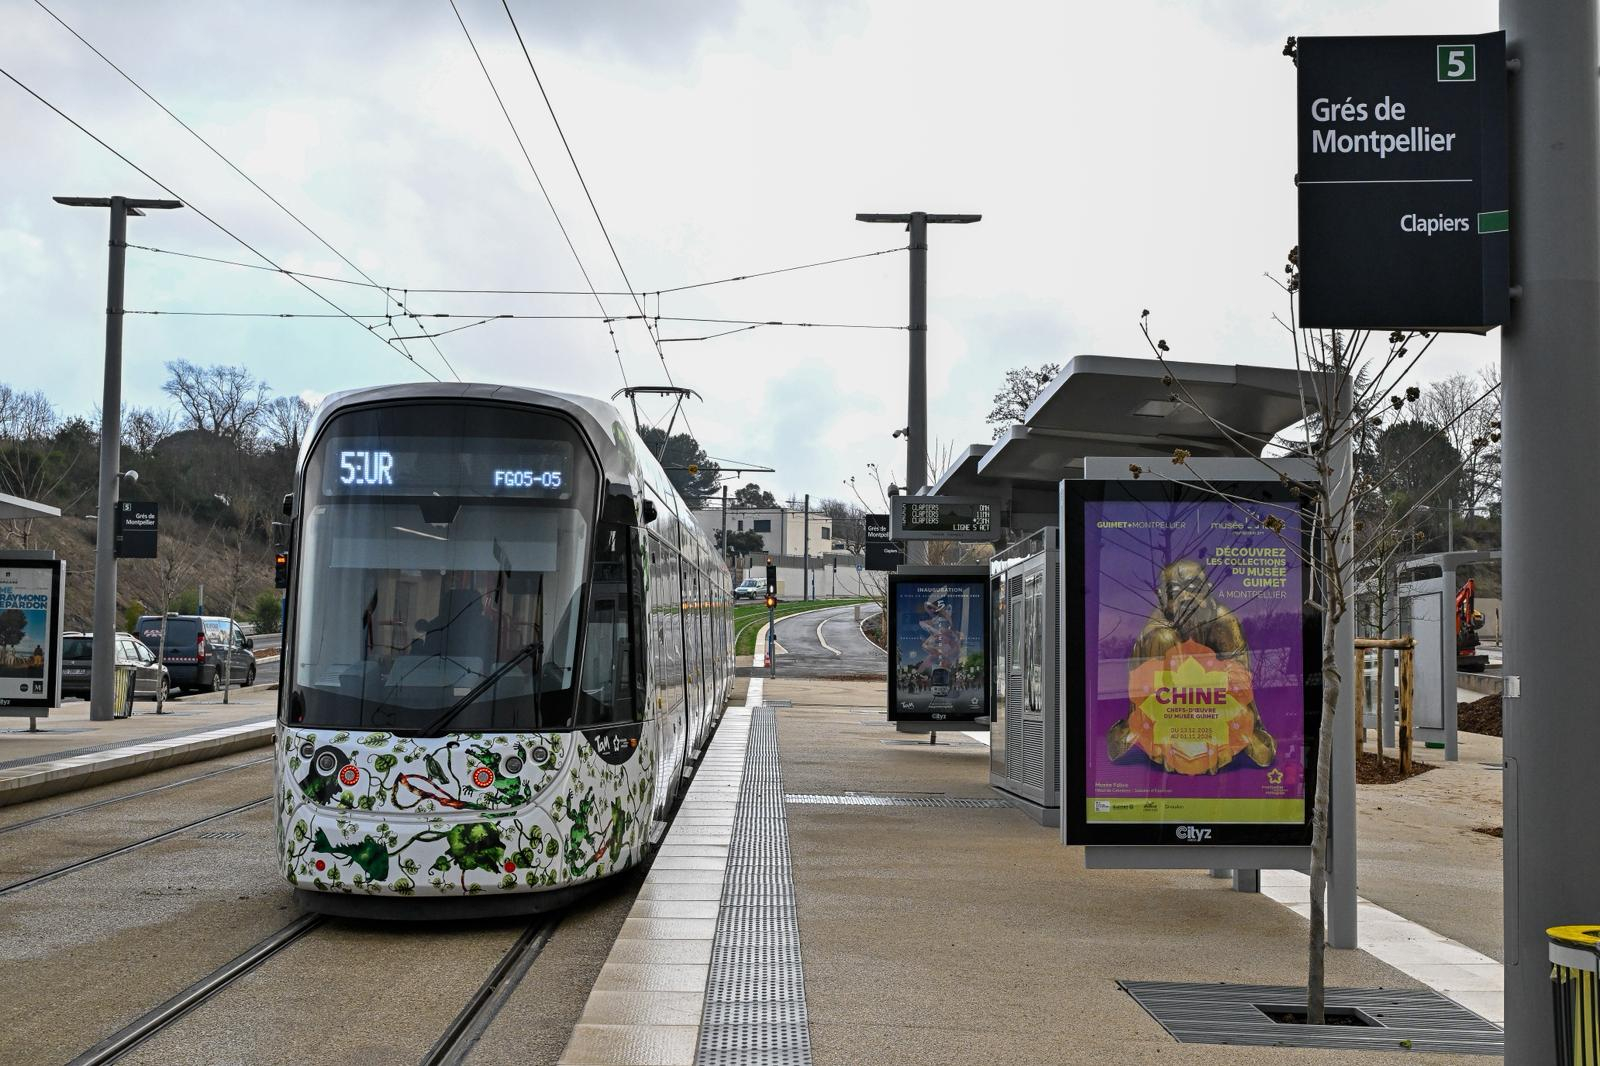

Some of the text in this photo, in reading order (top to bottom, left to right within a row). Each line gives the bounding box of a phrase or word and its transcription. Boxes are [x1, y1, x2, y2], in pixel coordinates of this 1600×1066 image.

[1447, 51, 1466, 77] 5
[1311, 96, 1406, 121] Grés de
[1312, 126, 1456, 158] Montpellier
[1400, 213, 1470, 236] Clapiers
[494, 470, 562, 487] FG05-05
[1215, 545, 1287, 557] DÉCOUVREZ
[1206, 558, 1287, 566] LES COLLECTIONS
[1232, 565, 1287, 577] DU MUSÉE
[1243, 578, 1287, 588] GUIMET
[0, 594, 48, 602] RAYMOND
[1226, 591, 1287, 599] MONTPELLIER
[0, 601, 48, 609] EPARDON
[1155, 687, 1227, 704] CHINE
[1175, 825, 1212, 842] Cityz
